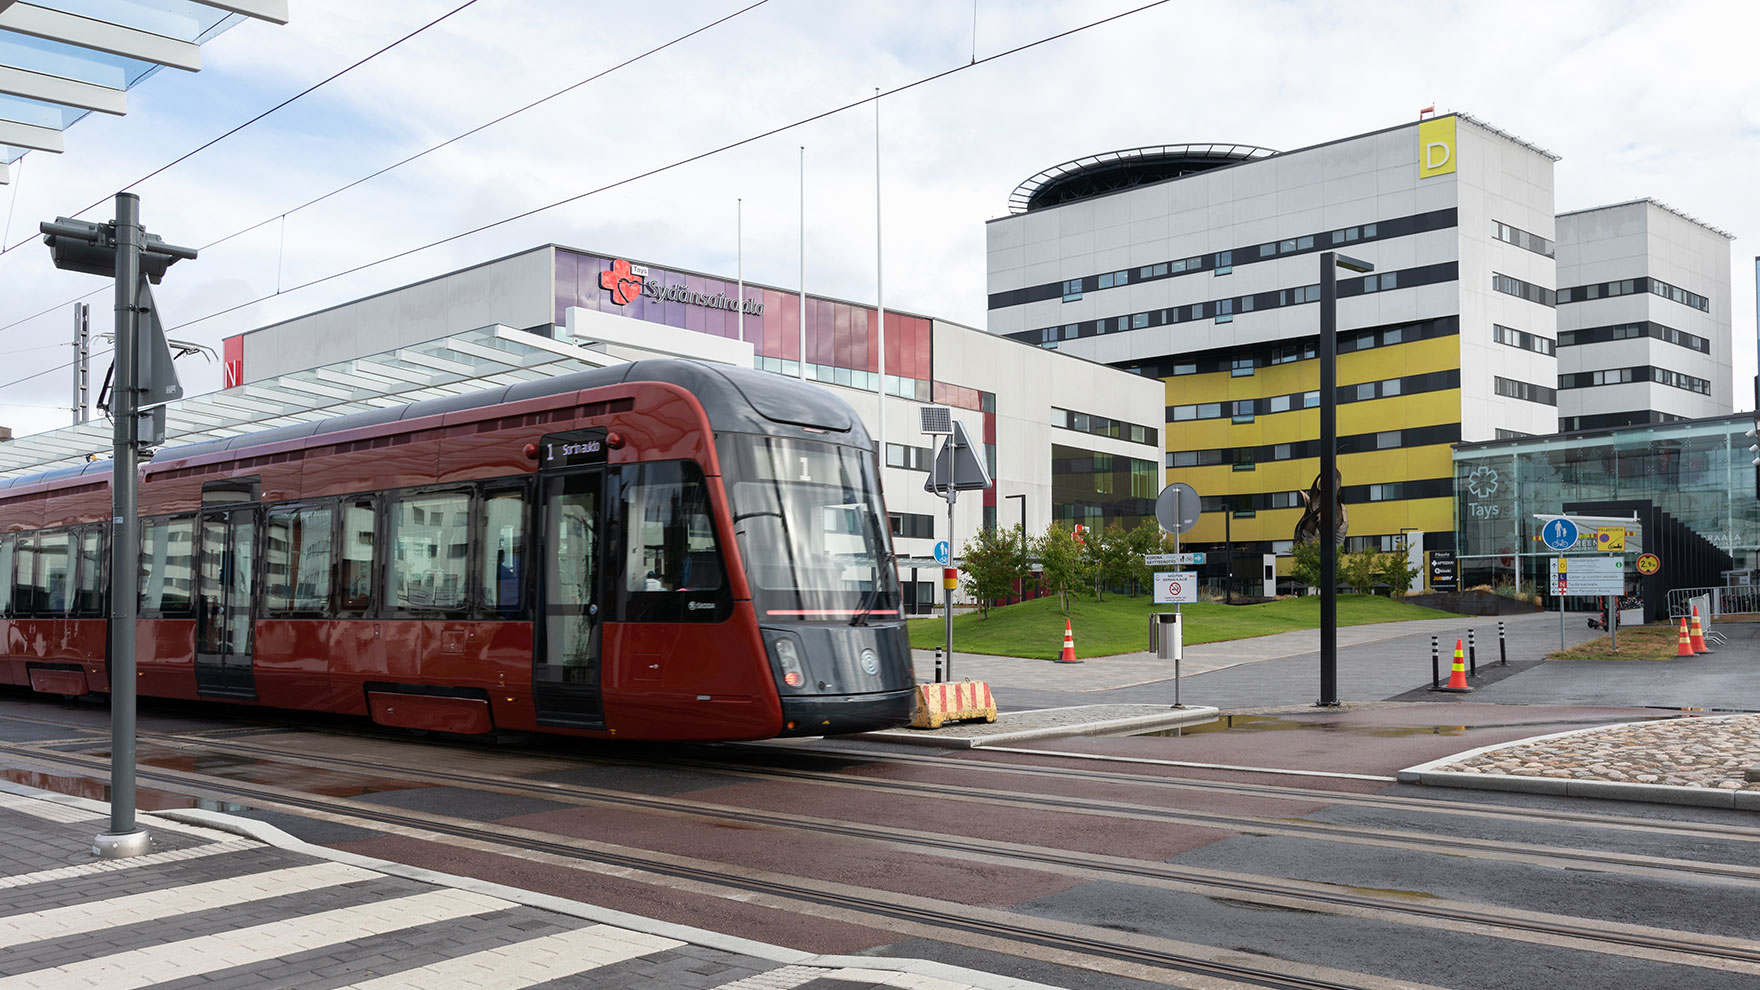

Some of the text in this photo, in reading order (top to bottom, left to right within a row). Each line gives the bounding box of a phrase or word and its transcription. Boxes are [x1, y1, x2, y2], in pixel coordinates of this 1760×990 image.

[1426, 141, 1450, 170] D
[648, 279, 765, 316] Sydänsairaala
[225, 359, 236, 389] N
[547, 443, 554, 460] 1
[798, 456, 812, 481] 1
[1469, 502, 1499, 520] Tays
